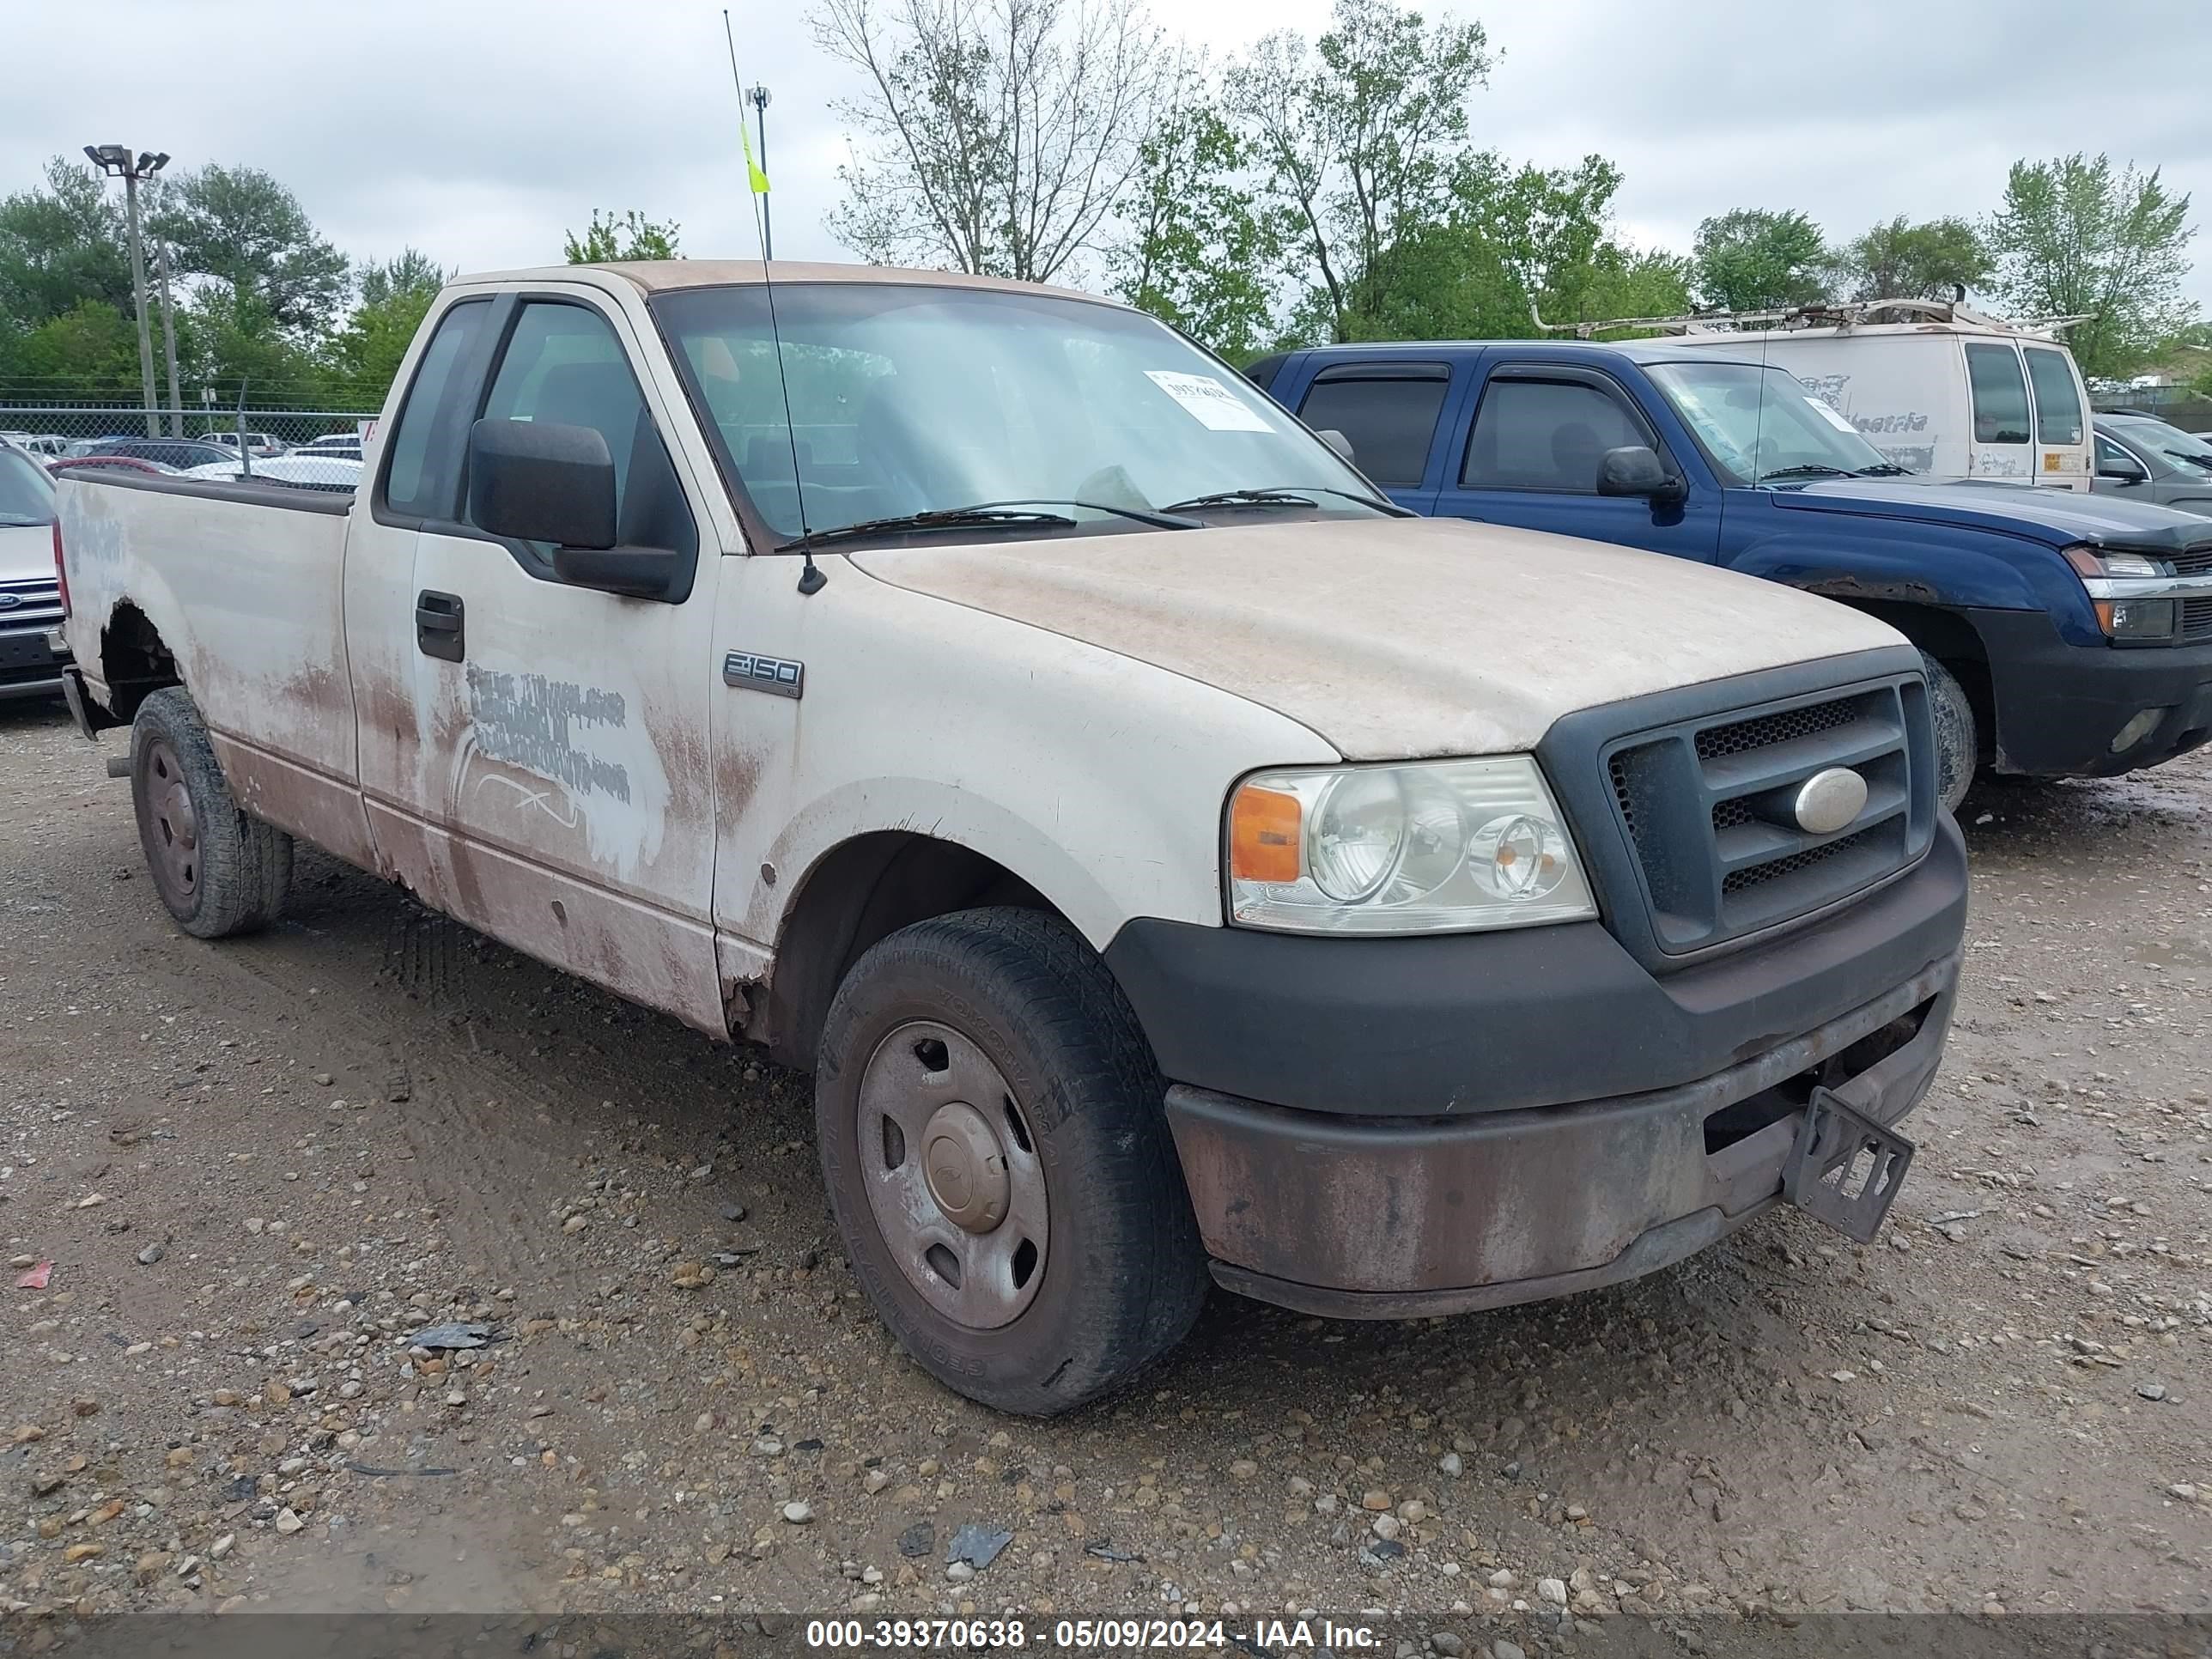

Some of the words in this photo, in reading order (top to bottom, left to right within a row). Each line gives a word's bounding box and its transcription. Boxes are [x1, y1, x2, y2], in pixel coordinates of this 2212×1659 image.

[724, 653, 799, 684] F-150
[786, 688, 798, 696] XL
[937, 988, 1059, 1167] YOKOHAMA
